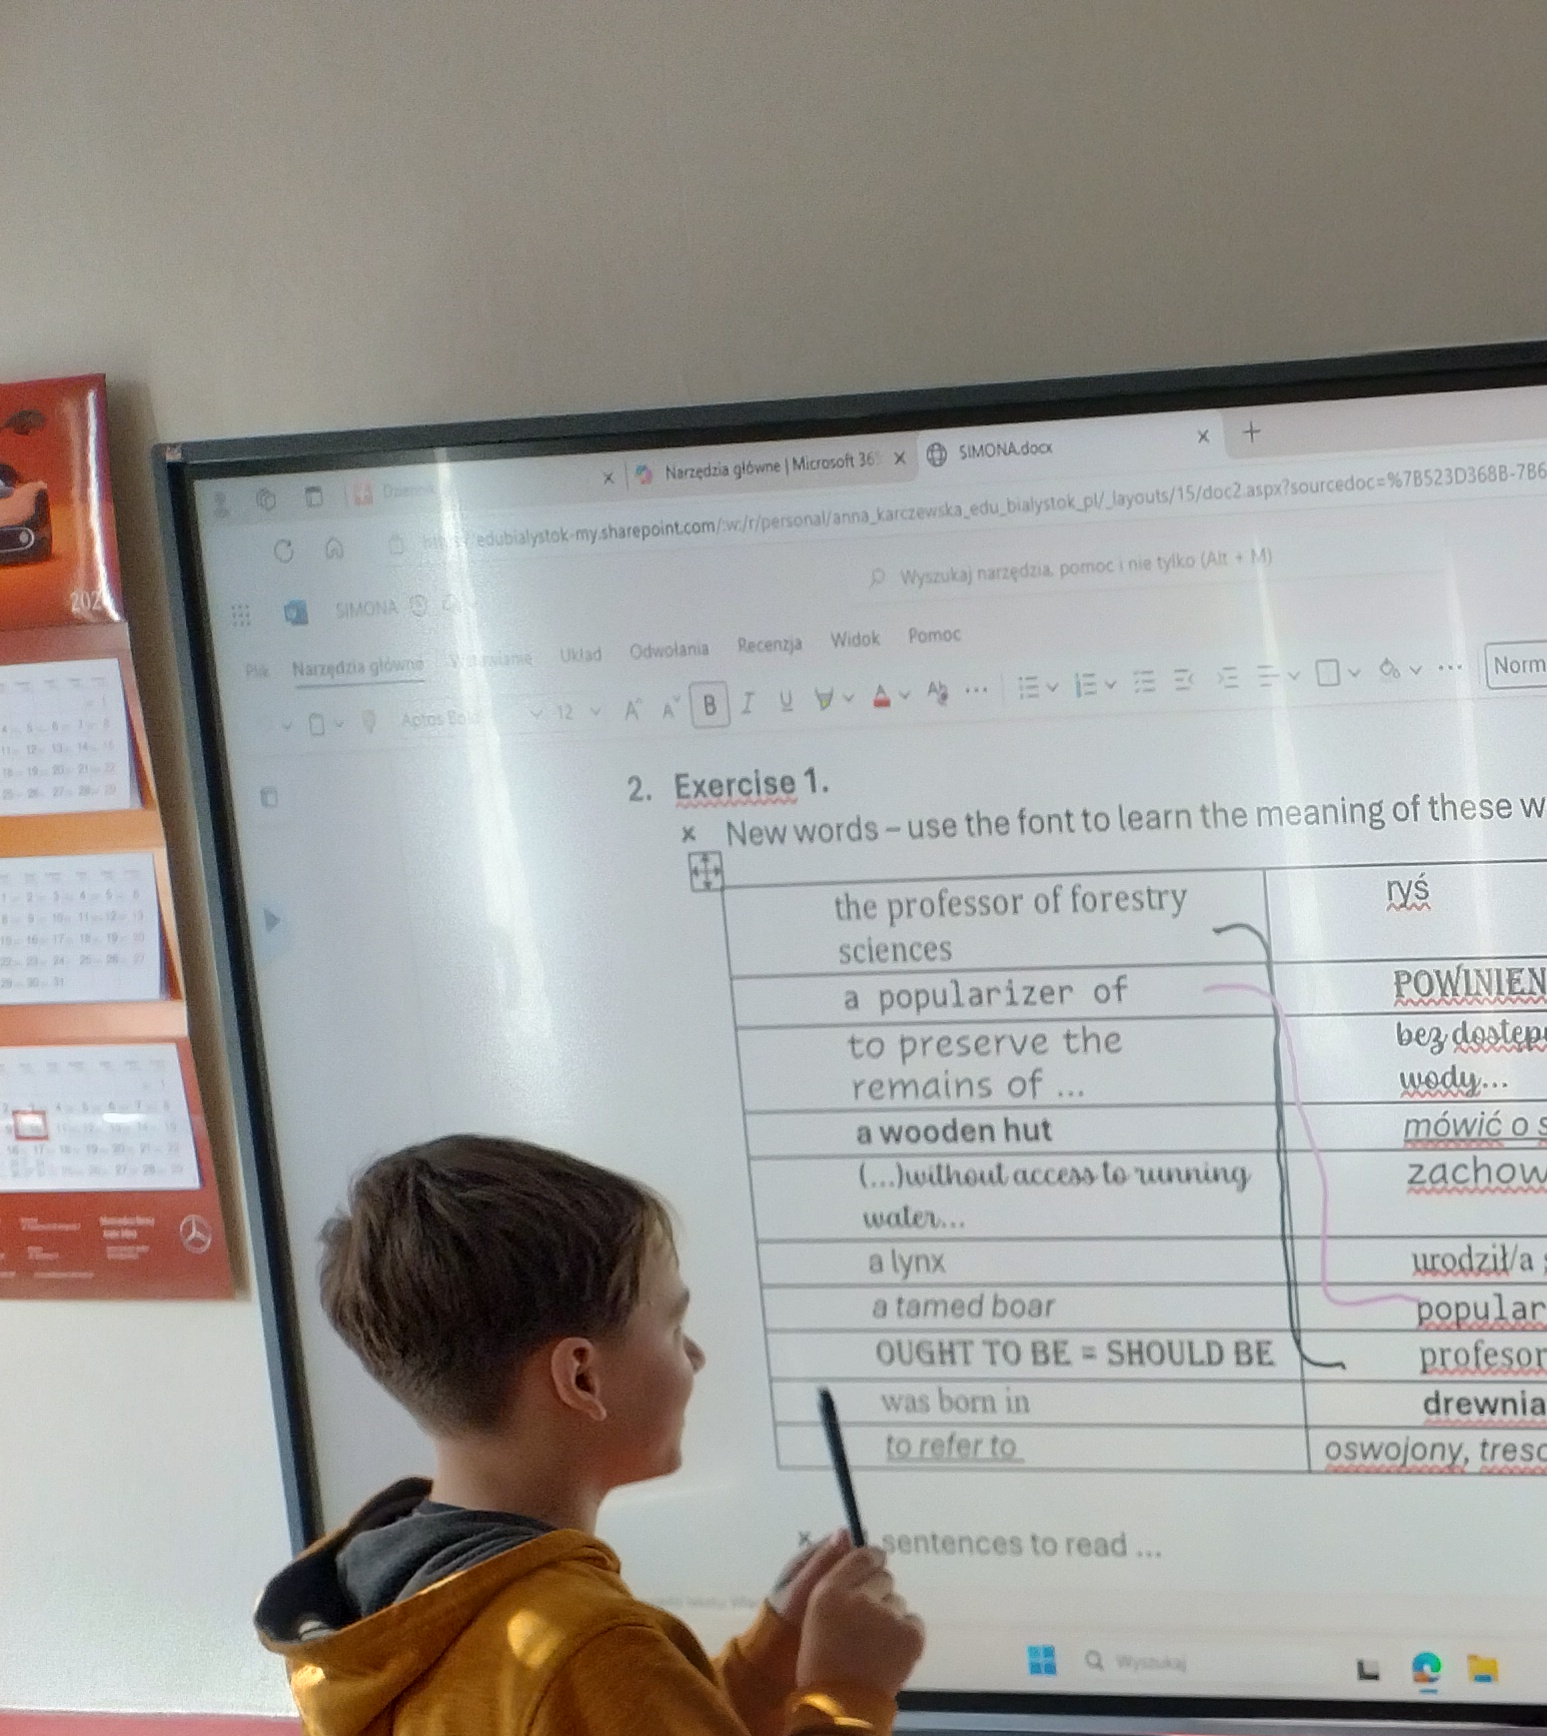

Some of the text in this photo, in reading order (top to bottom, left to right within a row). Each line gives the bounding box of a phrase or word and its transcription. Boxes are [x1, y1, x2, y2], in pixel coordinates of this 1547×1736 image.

[958, 440, 1053, 462] SIMONA.docx
[665, 462, 730, 482] Narzędzia
[734, 459, 781, 481] główne
[792, 453, 855, 474] Microsoft
[900, 566, 973, 589] Wyszukaj
[1059, 557, 1115, 578] pomoc
[1128, 552, 1152, 572] nie
[1156, 549, 1196, 573] tylko
[1250, 546, 1273, 568] M)
[334, 598, 398, 621] SIMONA
[629, 639, 710, 661] Odwołania
[738, 637, 803, 658] Recenzja
[830, 630, 882, 650] Widok
[908, 626, 962, 645] Pomoc
[559, 645, 603, 664] Układ
[292, 660, 366, 682] Narzędzia
[556, 703, 574, 722] 12
[627, 766, 830, 802] 2. Exercise 1.
[726, 817, 788, 848] New
[793, 813, 880, 845] words
[907, 814, 961, 841] use
[965, 808, 1010, 838] the
[1017, 806, 1077, 837] font
[1082, 808, 1111, 834] to
[1117, 802, 1193, 833] learn
[1200, 801, 1249, 831] the
[1256, 797, 1385, 831] meaning
[1391, 793, 1422, 824] of
[1427, 791, 1513, 823] these
[834, 883, 1188, 928] the professor of forestry
[1386, 873, 1432, 908] ryś
[839, 935, 953, 966] sciences
[844, 974, 1130, 1018] a popularizer of
[848, 1025, 1123, 1066] to preserve the
[1396, 1020, 1450, 1055] bez
[851, 1071, 993, 1102] remains
[1007, 1067, 1045, 1097] of
[1399, 1063, 1510, 1099] wody...
[856, 1115, 1054, 1146] a wooden hut
[1403, 1109, 1503, 1139] mówić
[1511, 1115, 1529, 1139] o
[1013, 1163, 1098, 1187] access
[1101, 1161, 1130, 1187] to
[1134, 1160, 1253, 1193] running
[869, 1246, 947, 1281] a lynx
[1411, 1241, 1535, 1273] urodził/a
[872, 1292, 1057, 1320] a tamed boar
[876, 1339, 975, 1367] OUGHT
[981, 1339, 1023, 1366] TO
[1031, 1339, 1072, 1366] BE
[1106, 1339, 1225, 1367] SHOULD
[1234, 1339, 1277, 1367] BE
[881, 1386, 1032, 1414] was born in
[885, 1432, 1018, 1460] to refer to
[1325, 1438, 1472, 1468] oswojony,
[881, 1530, 1024, 1560] sentences
[1030, 1531, 1059, 1560] to
[1064, 1531, 1129, 1560] read
